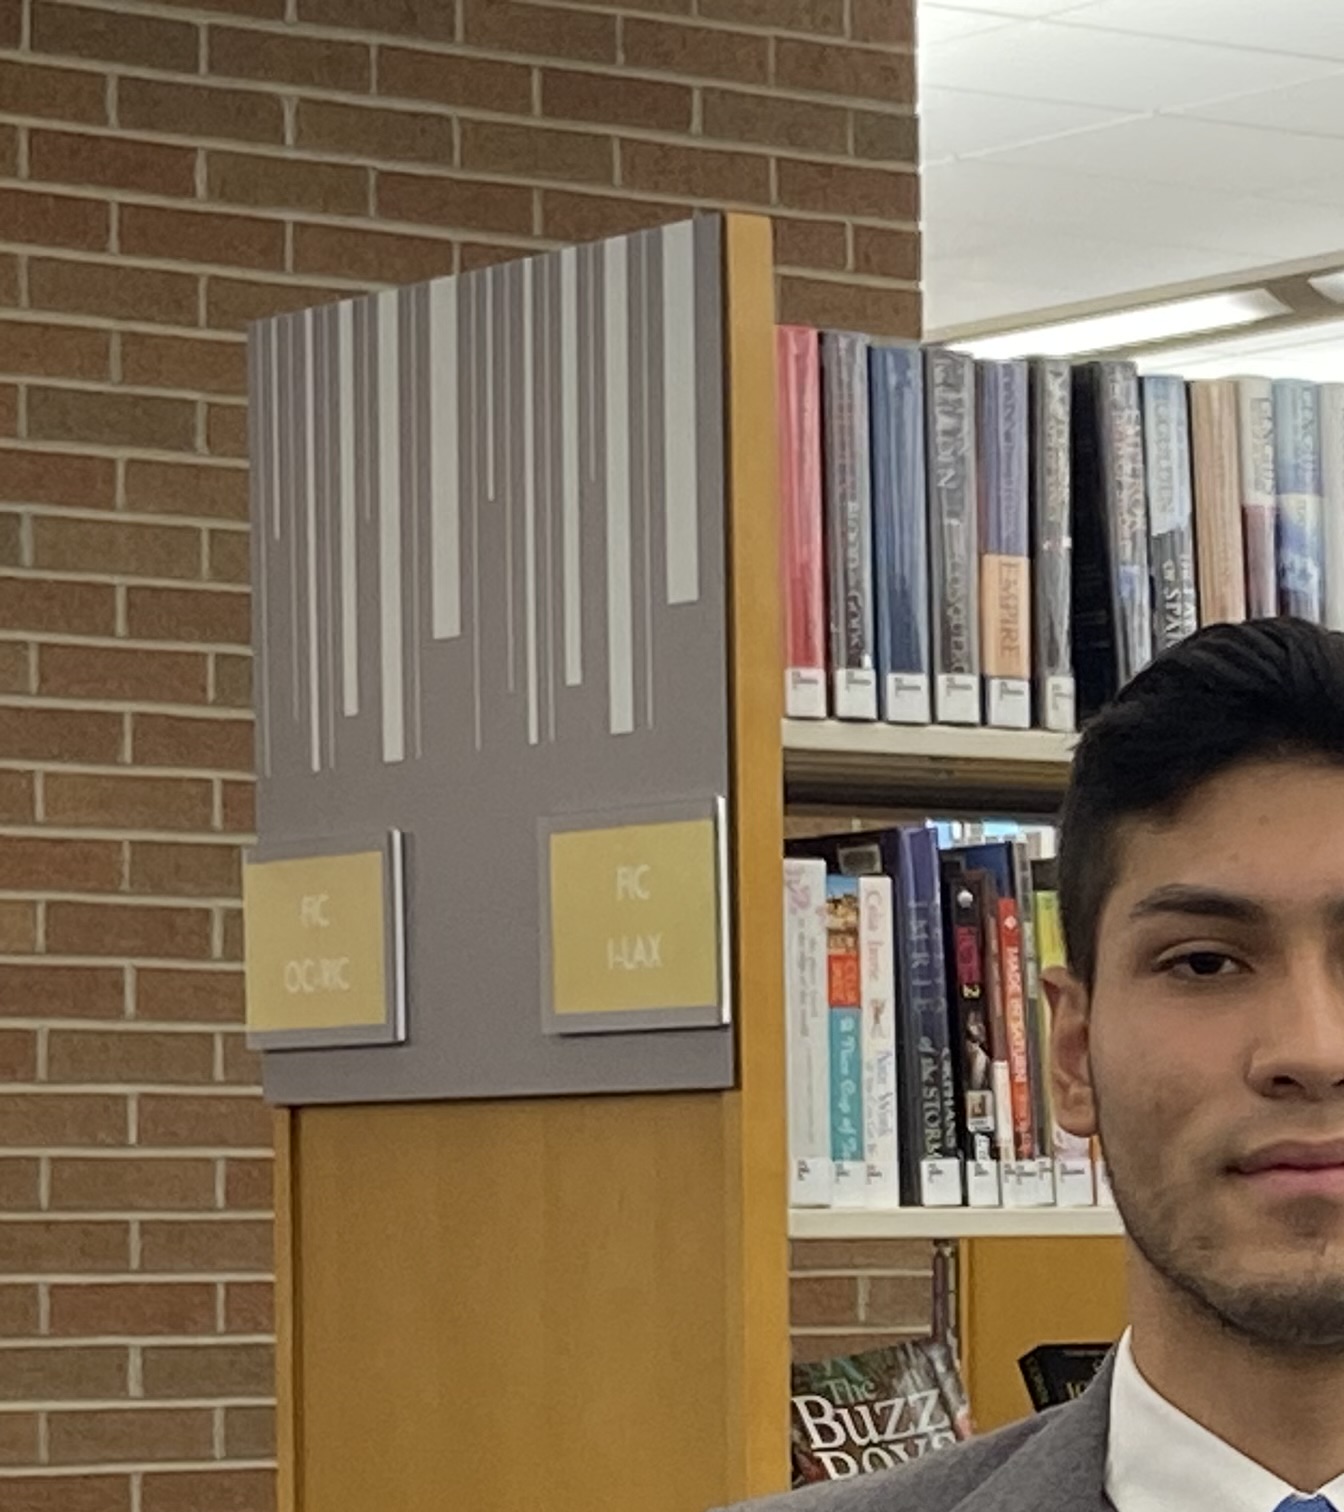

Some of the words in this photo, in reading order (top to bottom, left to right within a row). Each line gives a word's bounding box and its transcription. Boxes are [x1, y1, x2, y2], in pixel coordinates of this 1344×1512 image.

[1000, 561, 1022, 660] EMPIRE
[615, 863, 652, 902] FIC
[1006, 946, 1020, 993] MADE
[1008, 998, 1021, 1015] IN
[1010, 1019, 1027, 1083] SATURN
[921, 1058, 936, 1083] the
[838, 1079, 857, 1113] Cup
[841, 1117, 857, 1135] of
[824, 1379, 878, 1405] The
[792, 1386, 951, 1451] Buzz
